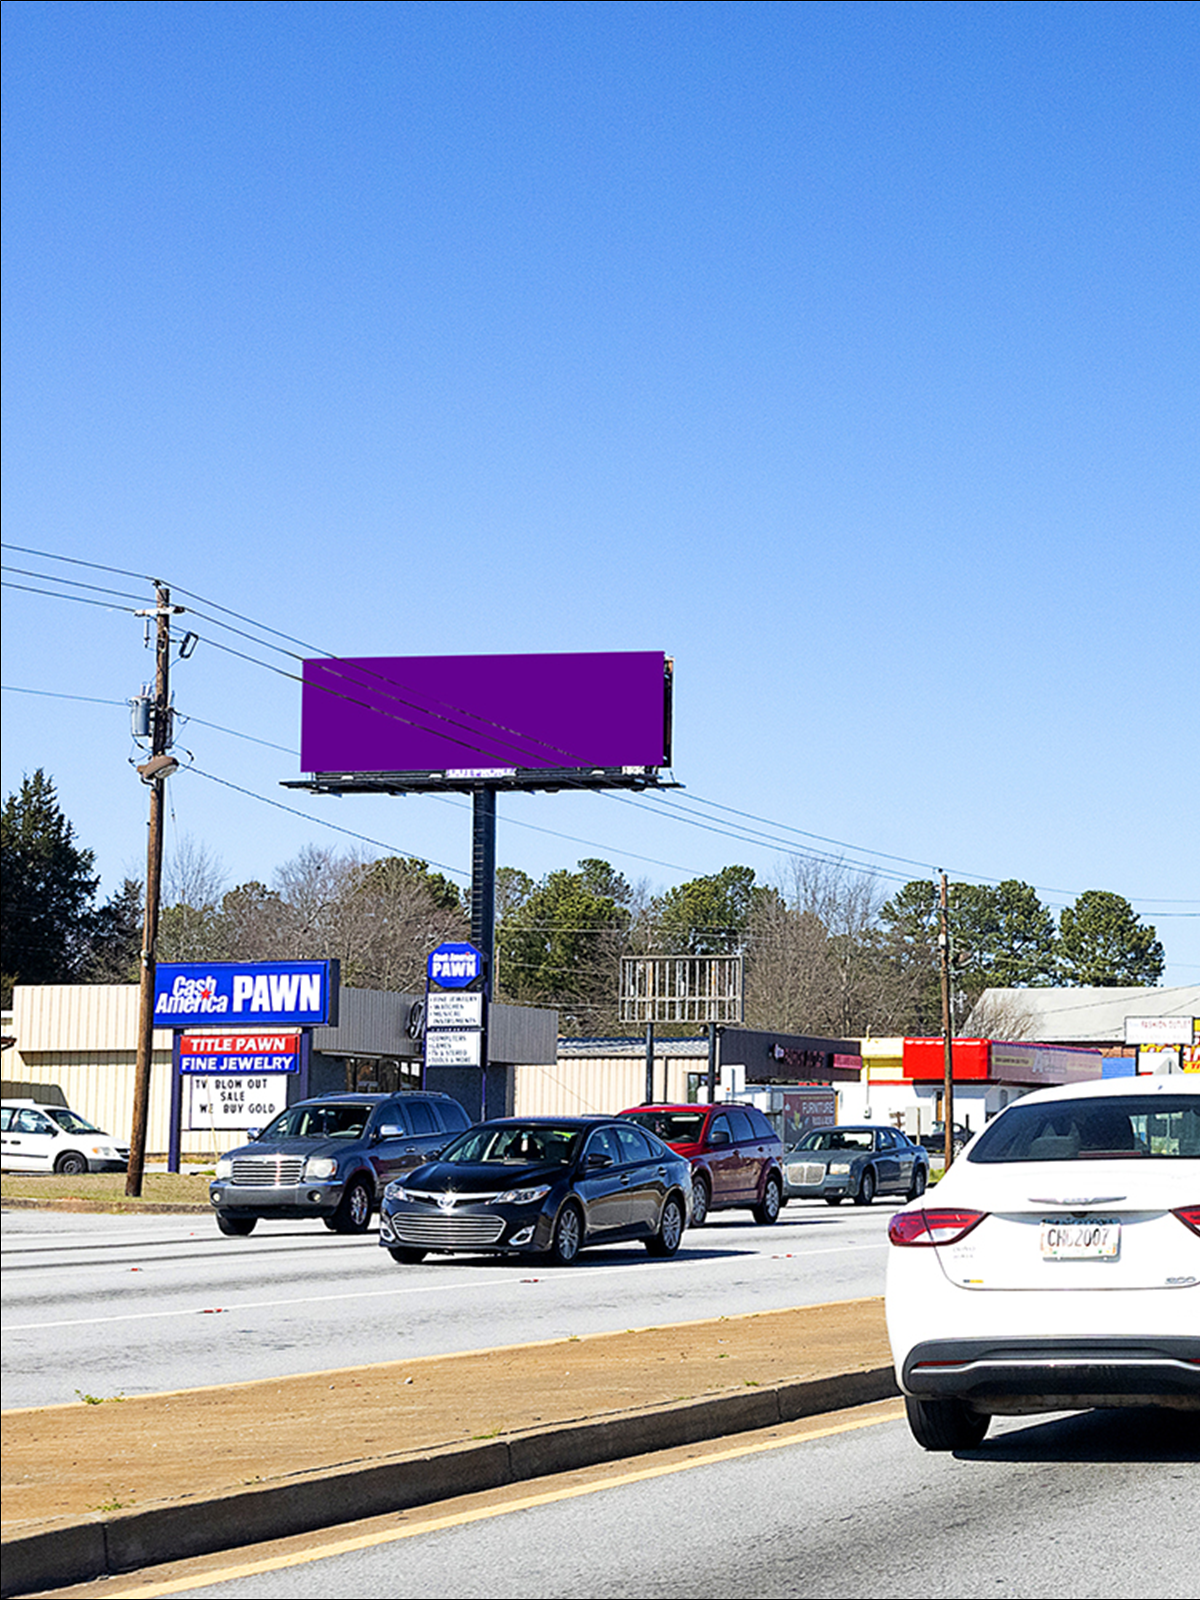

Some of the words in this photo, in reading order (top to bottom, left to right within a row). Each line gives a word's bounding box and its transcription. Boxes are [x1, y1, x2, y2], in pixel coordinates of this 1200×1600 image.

[432, 962, 476, 977] PAWN
[172, 975, 217, 997] Cash
[232, 974, 320, 1012] PAWN
[155, 992, 228, 1013] America
[190, 1038, 232, 1051] TITLE
[236, 1037, 286, 1051] PAWN
[181, 1057, 218, 1070] FINE
[220, 1056, 294, 1070] JEWELRY
[195, 1079, 208, 1089] TV
[215, 1079, 242, 1089] BLOW
[247, 1079, 267, 1089] OUT
[220, 1091, 245, 1101] SALE
[199, 1103, 214, 1114] WE
[223, 1103, 244, 1114] BUY
[248, 1103, 275, 1114] GOLD
